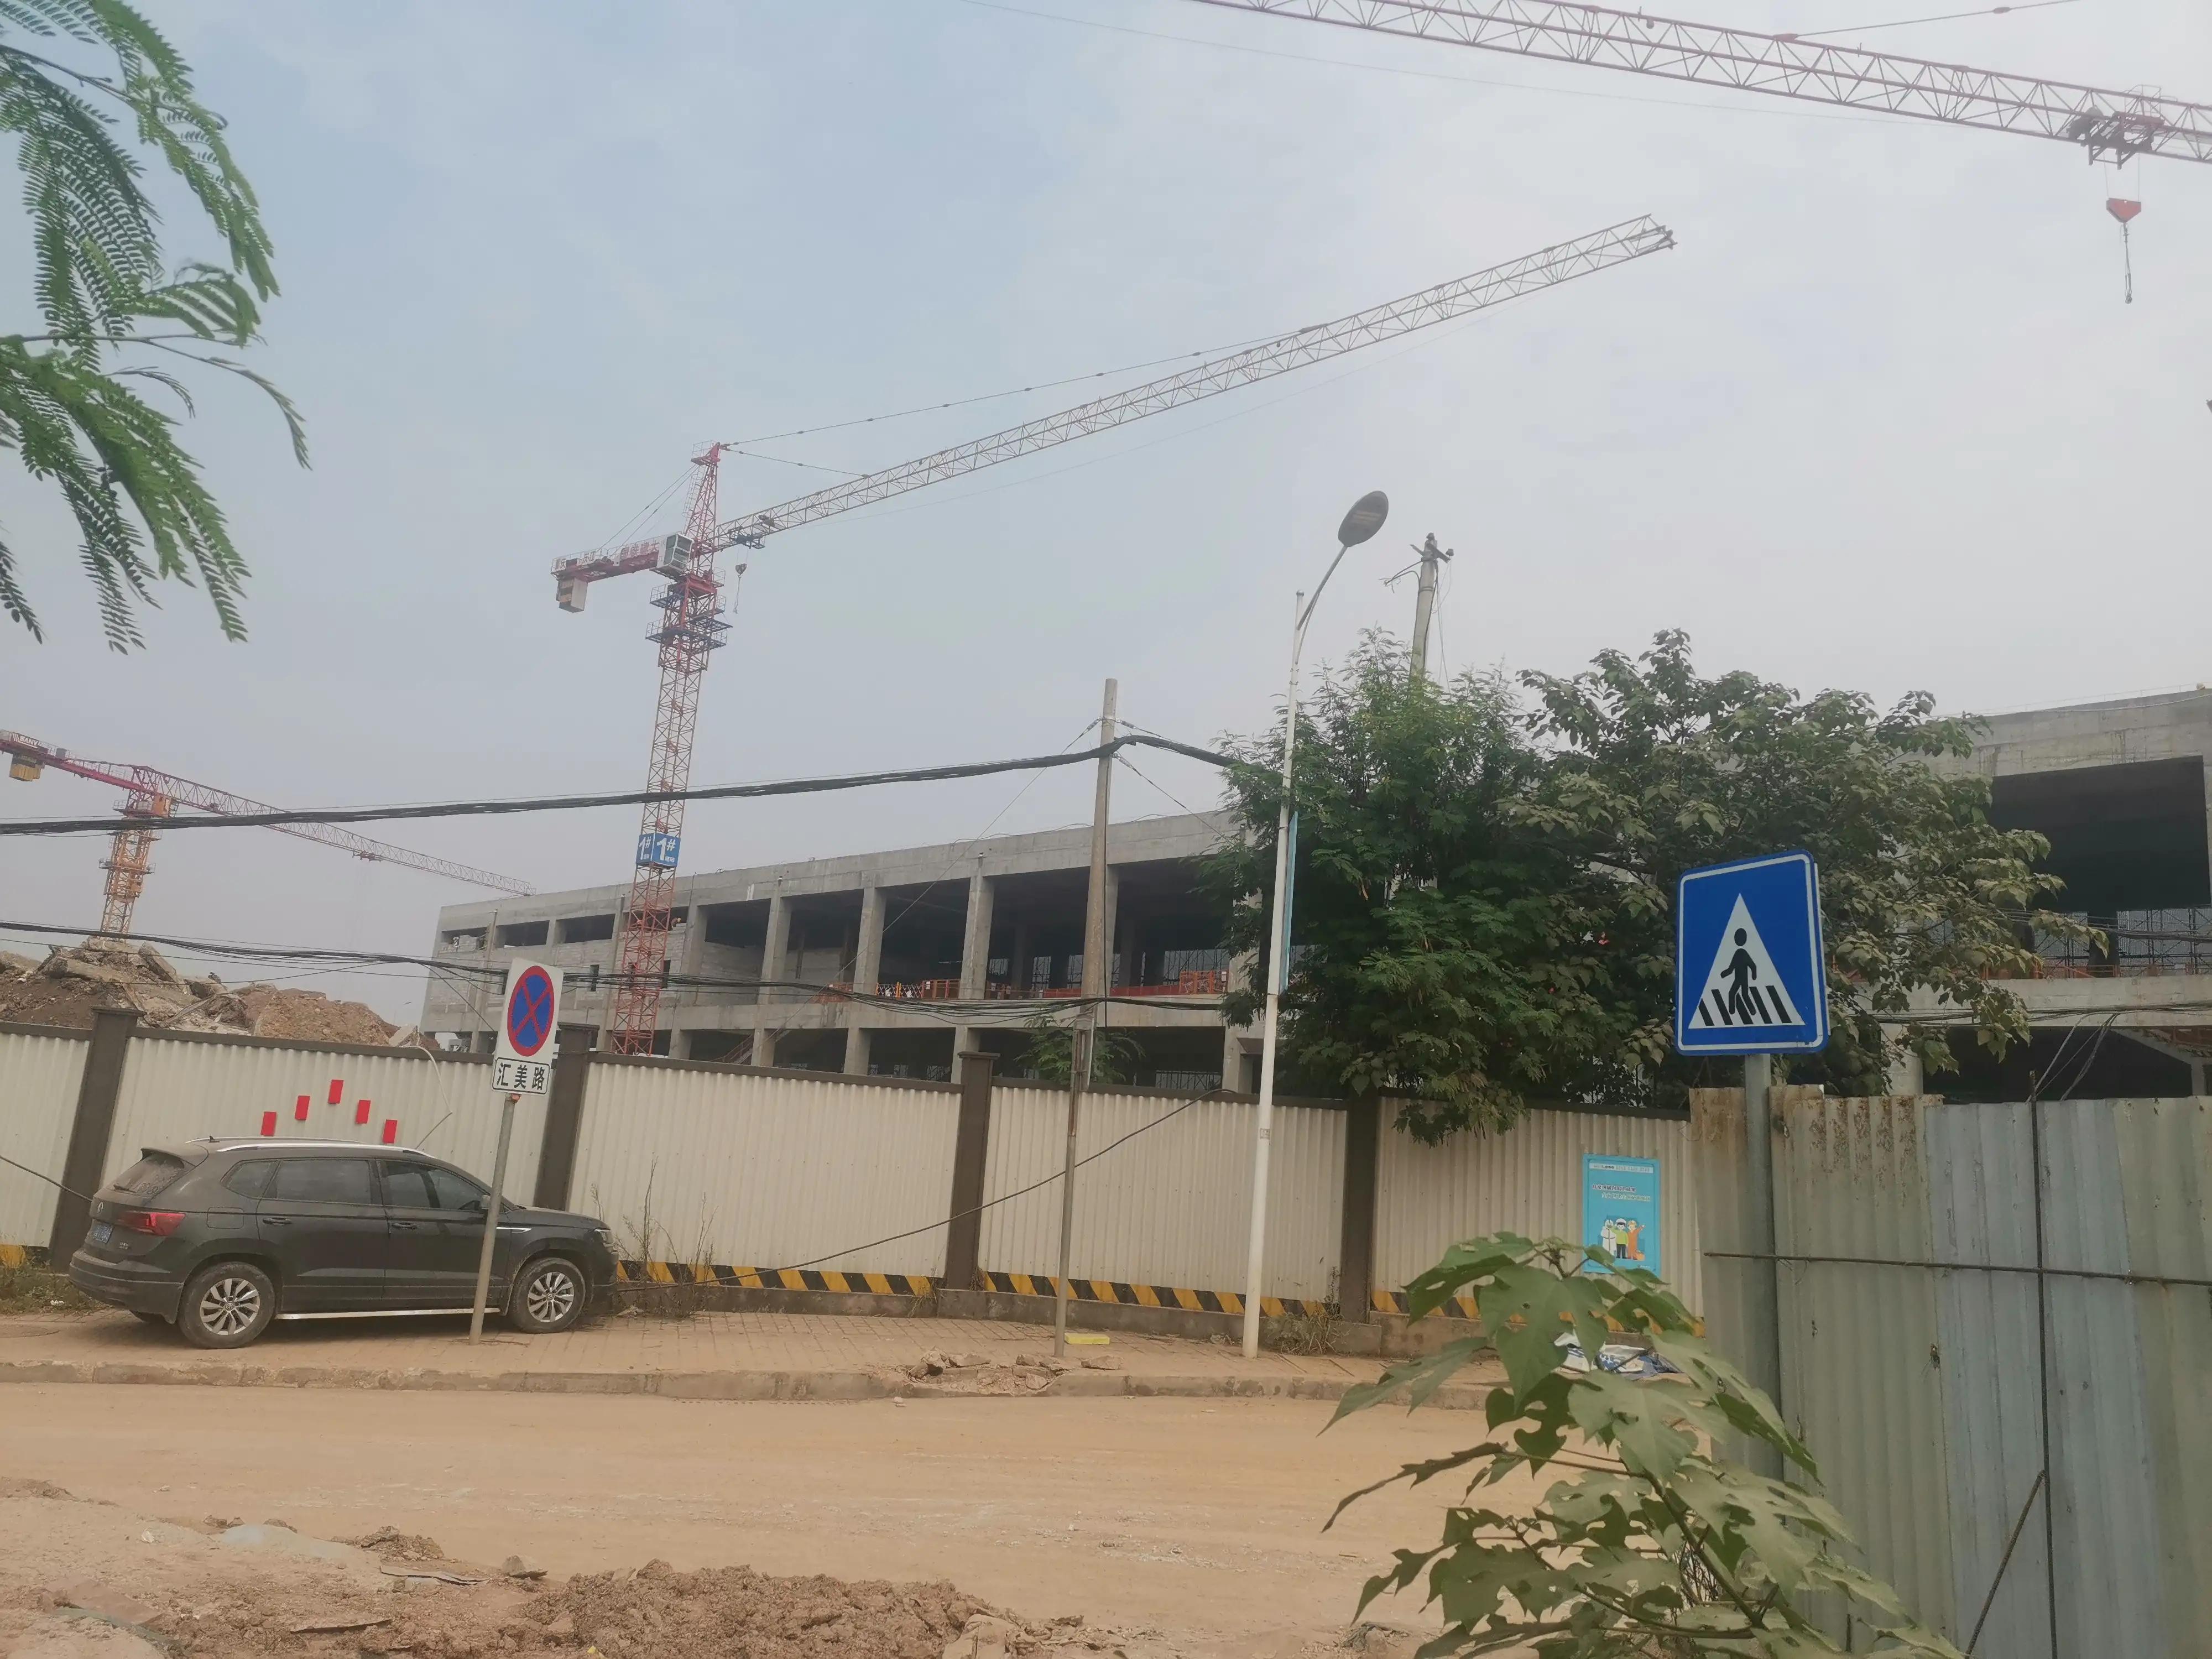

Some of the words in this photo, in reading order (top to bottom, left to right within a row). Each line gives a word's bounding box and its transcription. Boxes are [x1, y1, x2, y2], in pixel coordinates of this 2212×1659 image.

[20, 735, 39, 746] SANY
[639, 836, 651, 860] 1#
[656, 837, 676, 860] 1#
[497, 1062, 545, 1090] 汇美路
